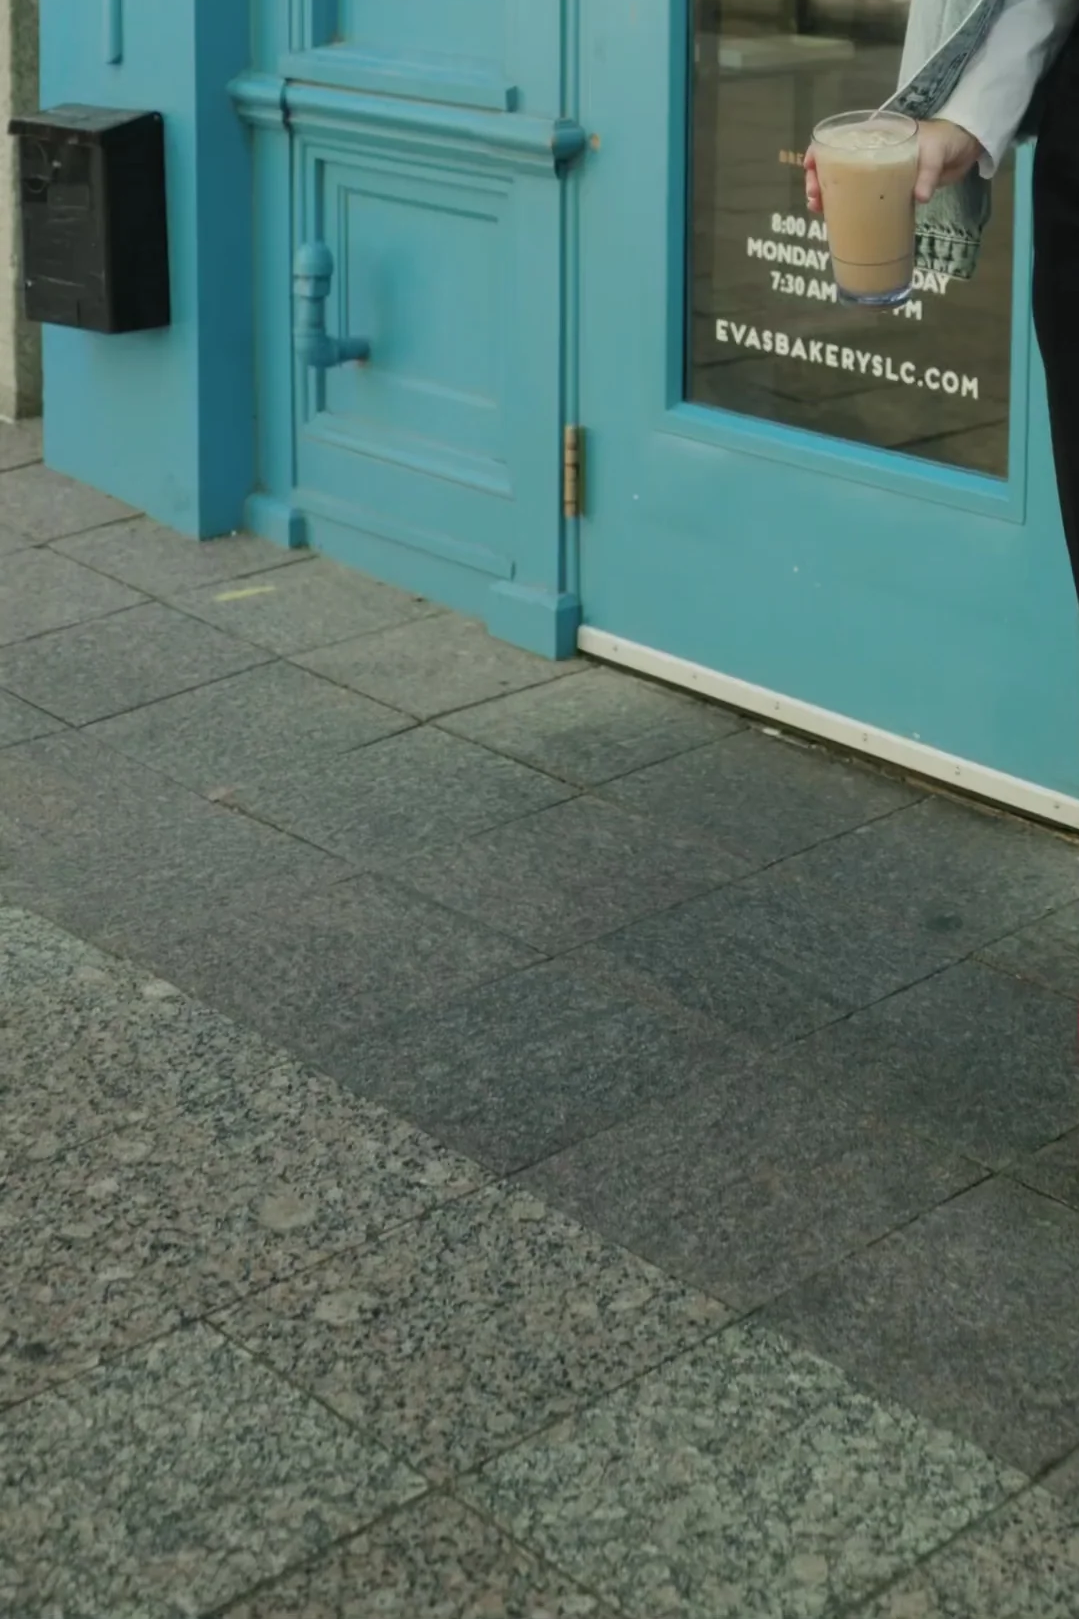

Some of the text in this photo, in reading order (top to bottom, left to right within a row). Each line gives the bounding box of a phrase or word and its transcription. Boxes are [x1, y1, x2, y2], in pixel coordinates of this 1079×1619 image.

[770, 213, 806, 237] 8:00
[747, 237, 830, 271] MONDAY
[770, 271, 805, 296] 7:30
[806, 279, 838, 303] AM
[715, 319, 980, 399] EVASBAKERYSLC.COM
